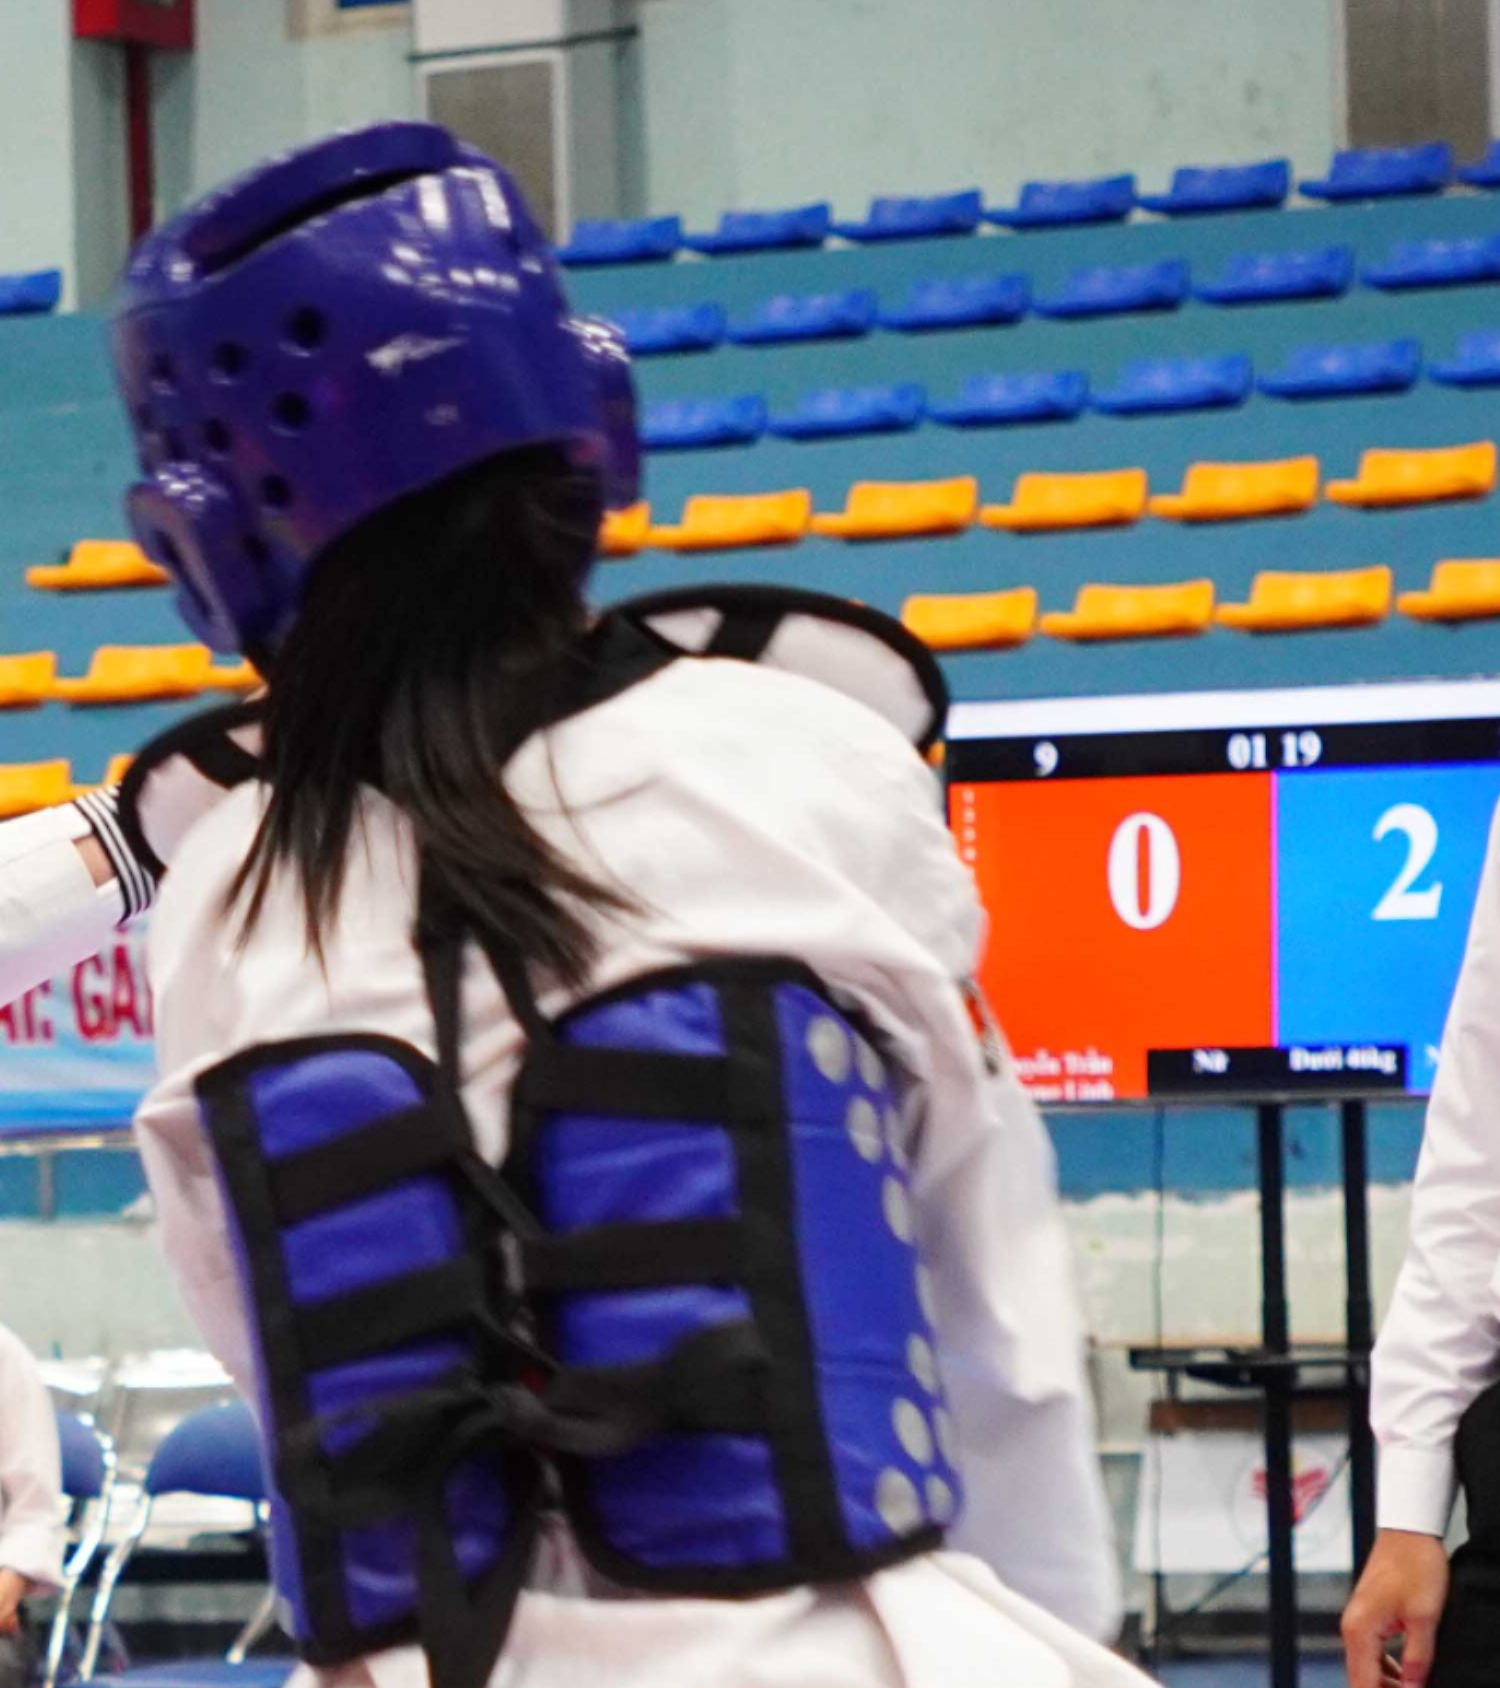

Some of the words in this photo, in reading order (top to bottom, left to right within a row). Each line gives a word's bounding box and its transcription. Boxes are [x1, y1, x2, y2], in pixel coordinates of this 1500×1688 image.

[1033, 741, 1059, 777] 9
[1227, 733, 1268, 770] 01
[1280, 730, 1322, 768] 19
[1107, 811, 1181, 930] 0
[1371, 802, 1445, 922] 2
